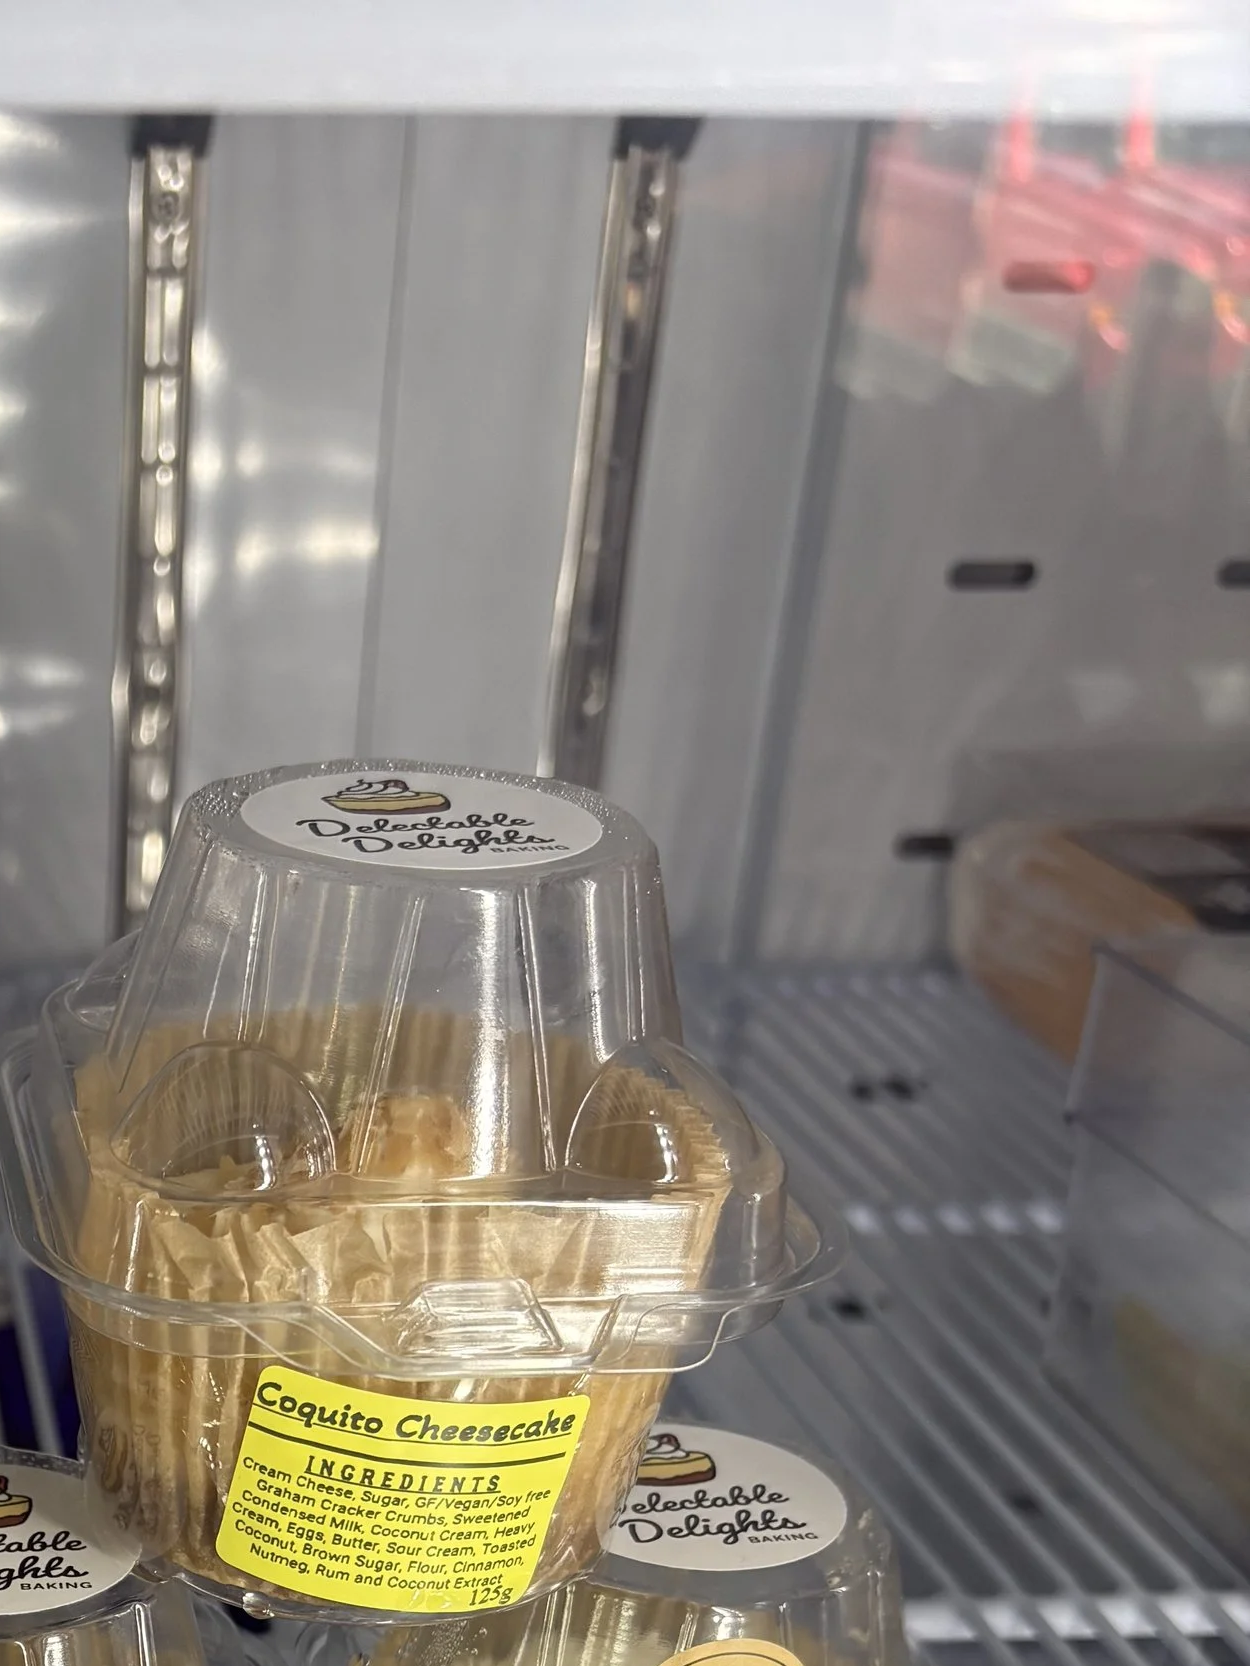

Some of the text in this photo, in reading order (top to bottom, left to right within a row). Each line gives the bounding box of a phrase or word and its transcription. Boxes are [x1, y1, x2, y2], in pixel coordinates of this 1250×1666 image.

[296, 813, 534, 837] Delectable
[342, 830, 555, 854] Delights
[491, 844, 570, 854] BAKING
[257, 1381, 575, 1443] Coquito Cheesecake
[243, 1456, 551, 1511] Cream Cheese, Sugar, GF/Vegan/Soy free
[305, 1455, 500, 1492] INGREDIENTS
[242, 1489, 535, 1541] Condensed Milk, Coconut Cream, Heavy
[257, 1478, 531, 1527] Graham Cracker Crumbs, Sweetened
[628, 1484, 790, 1514] electable
[232, 1501, 536, 1557] Cream, Eggs, Butter, Sour Cream, Toasted
[618, 1509, 806, 1545] Delights
[749, 1532, 819, 1543] BAKING
[235, 1518, 524, 1575] Coconut, Brown Sugar, Flour, Cinnamon,
[249, 1542, 503, 1590] Nutmeg, Rum and Coconut Extract
[20, 1581, 93, 1591] BAKING
[469, 1585, 513, 1606] 125g
